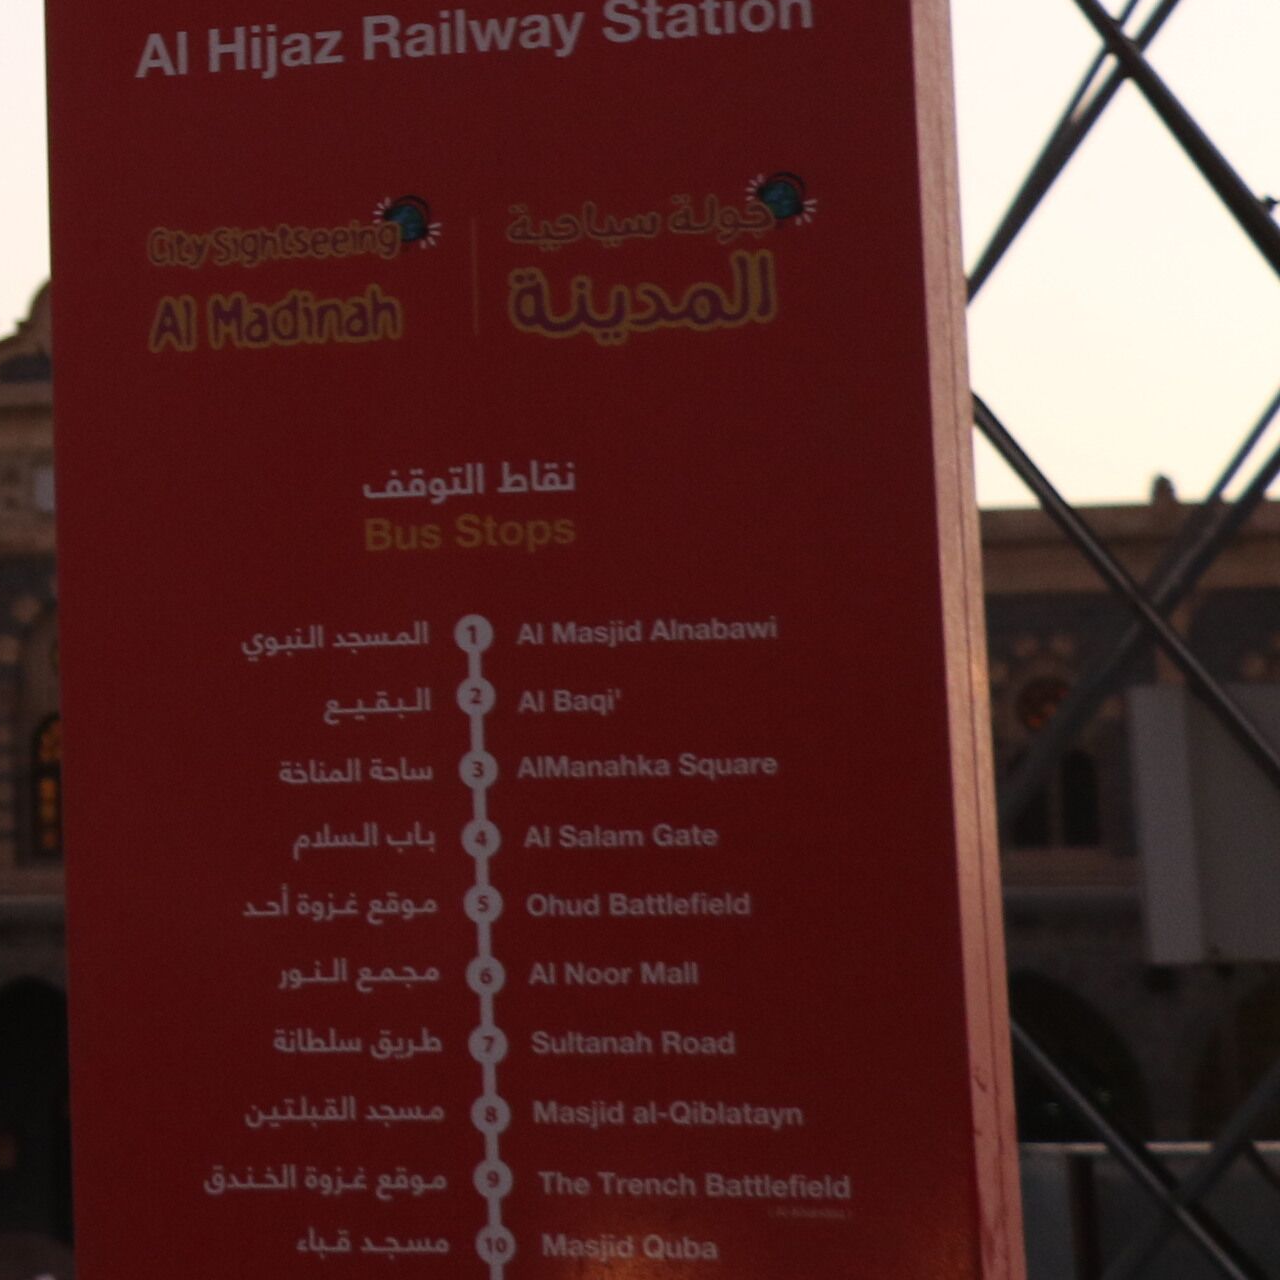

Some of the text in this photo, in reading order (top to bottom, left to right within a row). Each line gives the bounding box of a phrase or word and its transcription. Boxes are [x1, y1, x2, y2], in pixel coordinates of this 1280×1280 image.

[135, 30, 189, 79] Al
[208, 23, 345, 80] Hijaz
[362, 8, 585, 61] Railway
[506, 201, 661, 252] سياحية
[147, 220, 401, 269] City Sightseeing
[508, 249, 777, 346] المدينة
[149, 283, 402, 353] Al Madinah
[362, 459, 576, 505] نقاط التوقف
[364, 512, 577, 553] Bus Stops
[241, 620, 430, 663] المسجد النبوي
[465, 623, 478, 646] 1
[516, 615, 778, 648] Al Masjid Alnabawi
[322, 686, 432, 726] البقيع
[469, 686, 483, 706] 2
[517, 688, 621, 717] Al Baqi'
[278, 757, 434, 785] ساحة المناخة
[472, 759, 486, 780] 3
[516, 752, 779, 781] AlManahka Square
[292, 821, 437, 861] باب السلام
[473, 829, 489, 848] 4
[523, 822, 719, 849] Al Salam Gate
[242, 884, 438, 926] موقع غزوة أحد
[476, 893, 491, 914] 5
[525, 892, 752, 918] Ohud Battlefield
[278, 957, 441, 994] مجمع النور
[478, 966, 495, 987] 6
[528, 961, 699, 986] Al Noor Mall
[272, 1027, 443, 1061] طريق سلطانة
[482, 1034, 497, 1054] 7
[531, 1029, 737, 1056] Sultanah Road
[244, 1095, 446, 1129] مسجد القبلتين
[483, 1105, 499, 1125] 8
[532, 1099, 804, 1131] Masjid al-Qiblatayn
[203, 1163, 448, 1201] موقع غزوة الخندق
[485, 1169, 502, 1189] 9
[537, 1170, 852, 1200] The Trench Battlefield
[296, 1226, 450, 1260] مسجد قباء
[483, 1235, 510, 1255] 10
[542, 1233, 719, 1264] Masjid Quba
